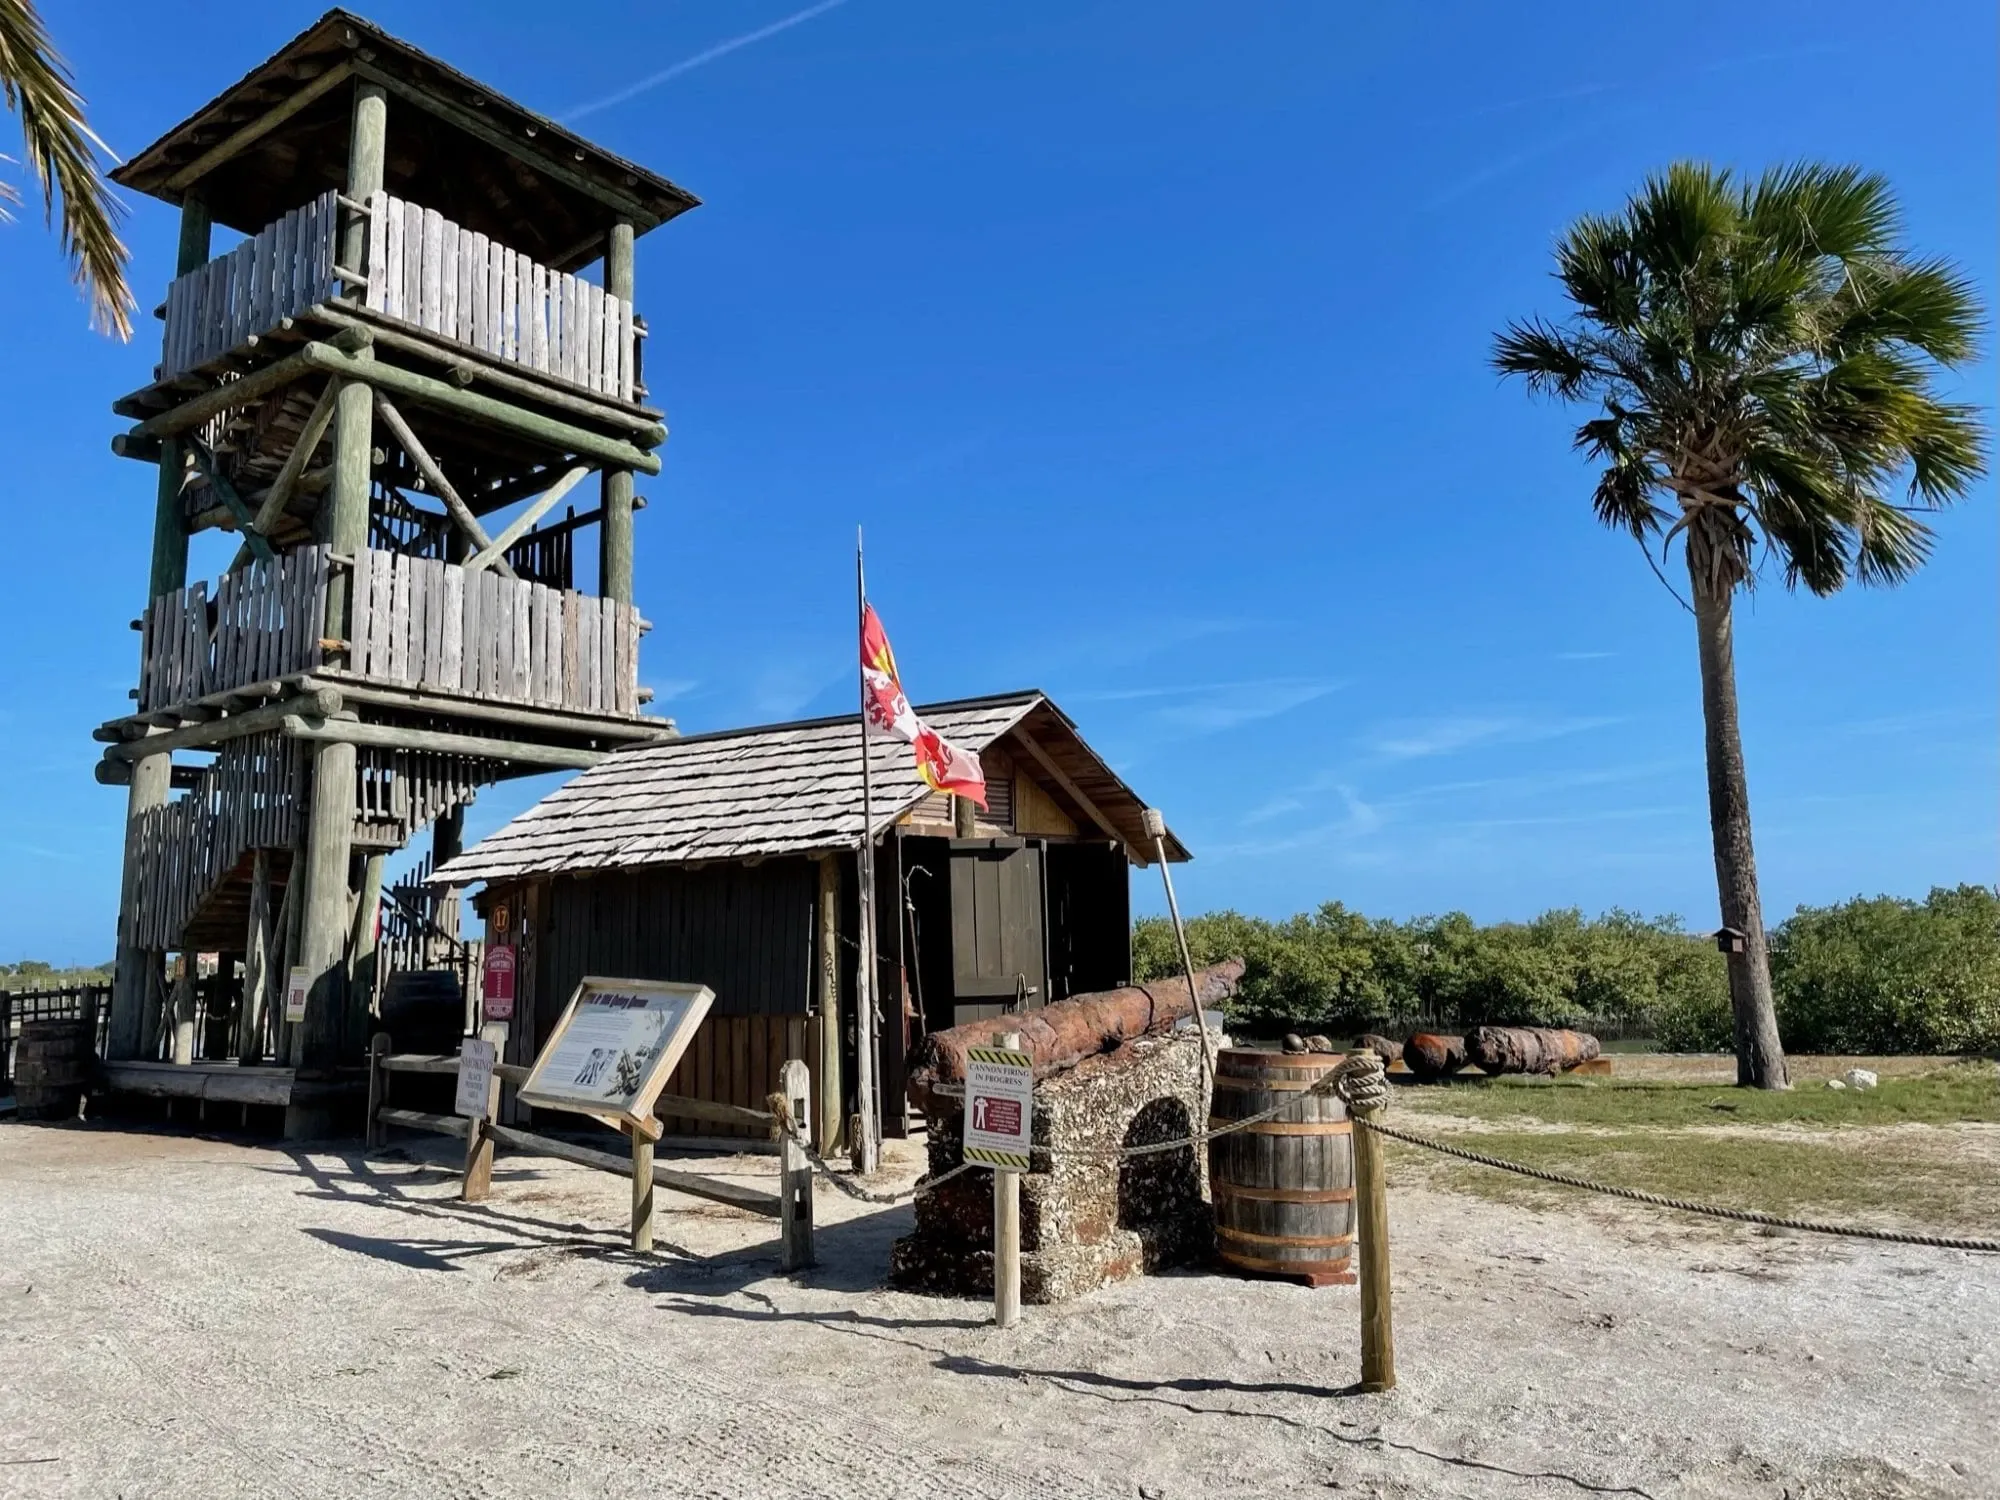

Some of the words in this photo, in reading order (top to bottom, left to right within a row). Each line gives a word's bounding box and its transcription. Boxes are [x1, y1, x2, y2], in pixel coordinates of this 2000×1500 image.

[496, 909, 507, 928] 17
[969, 1063, 1002, 1074] CANNON
[1003, 1067, 1030, 1077] FIRING
[975, 1073, 984, 1081] IN
[985, 1074, 1024, 1087] PROGRESS
